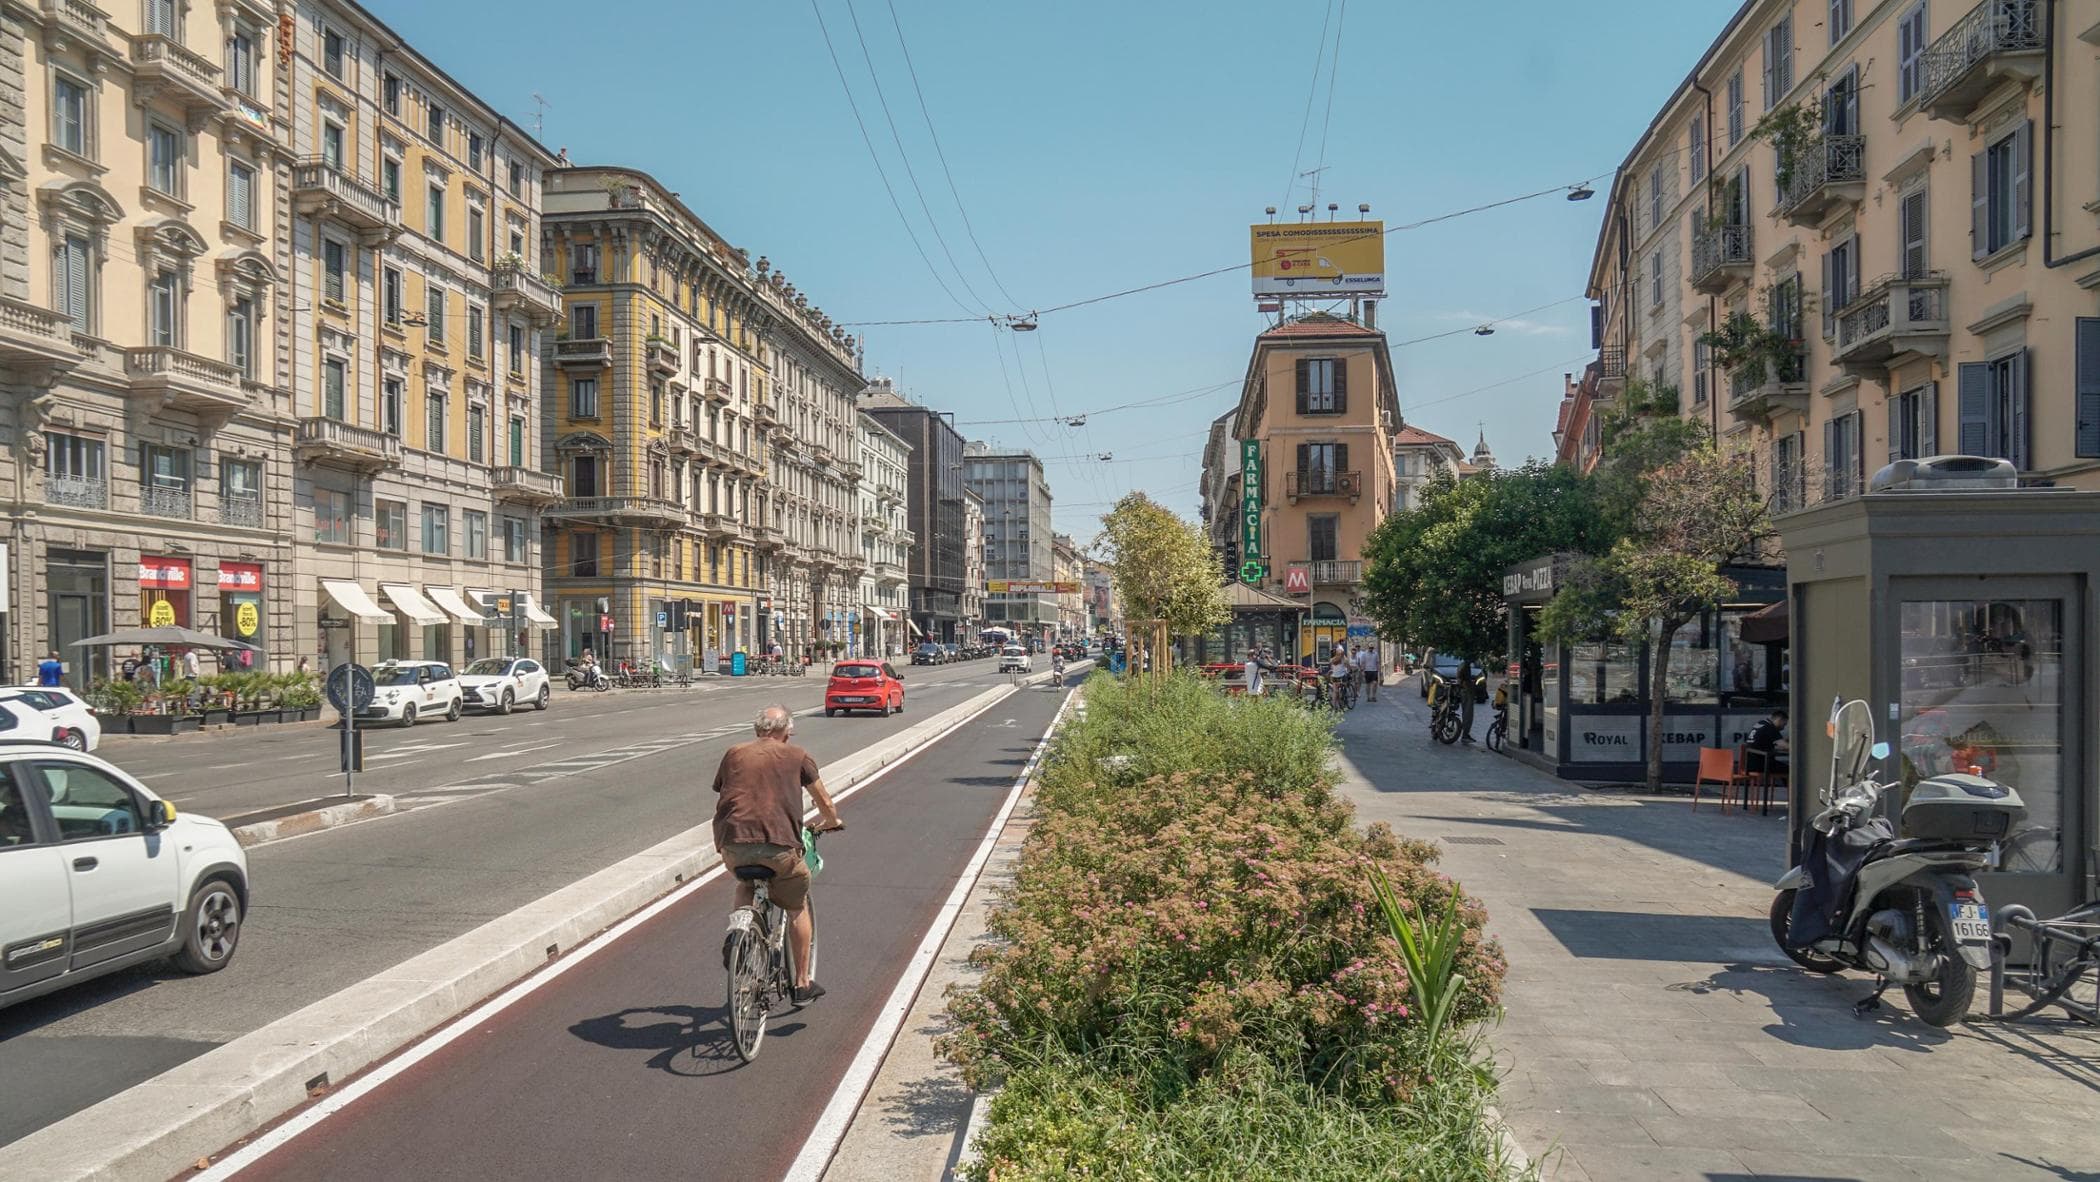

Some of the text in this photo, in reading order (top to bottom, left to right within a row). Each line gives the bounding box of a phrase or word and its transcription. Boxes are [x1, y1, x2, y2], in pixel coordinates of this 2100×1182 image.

[1246, 445, 1258, 554] FARMACIA
[1288, 572, 1306, 587] M
[1533, 566, 1552, 591] PIZZA
[240, 617, 256, 627] -80%
[1955, 922, 1989, 937] 16166
